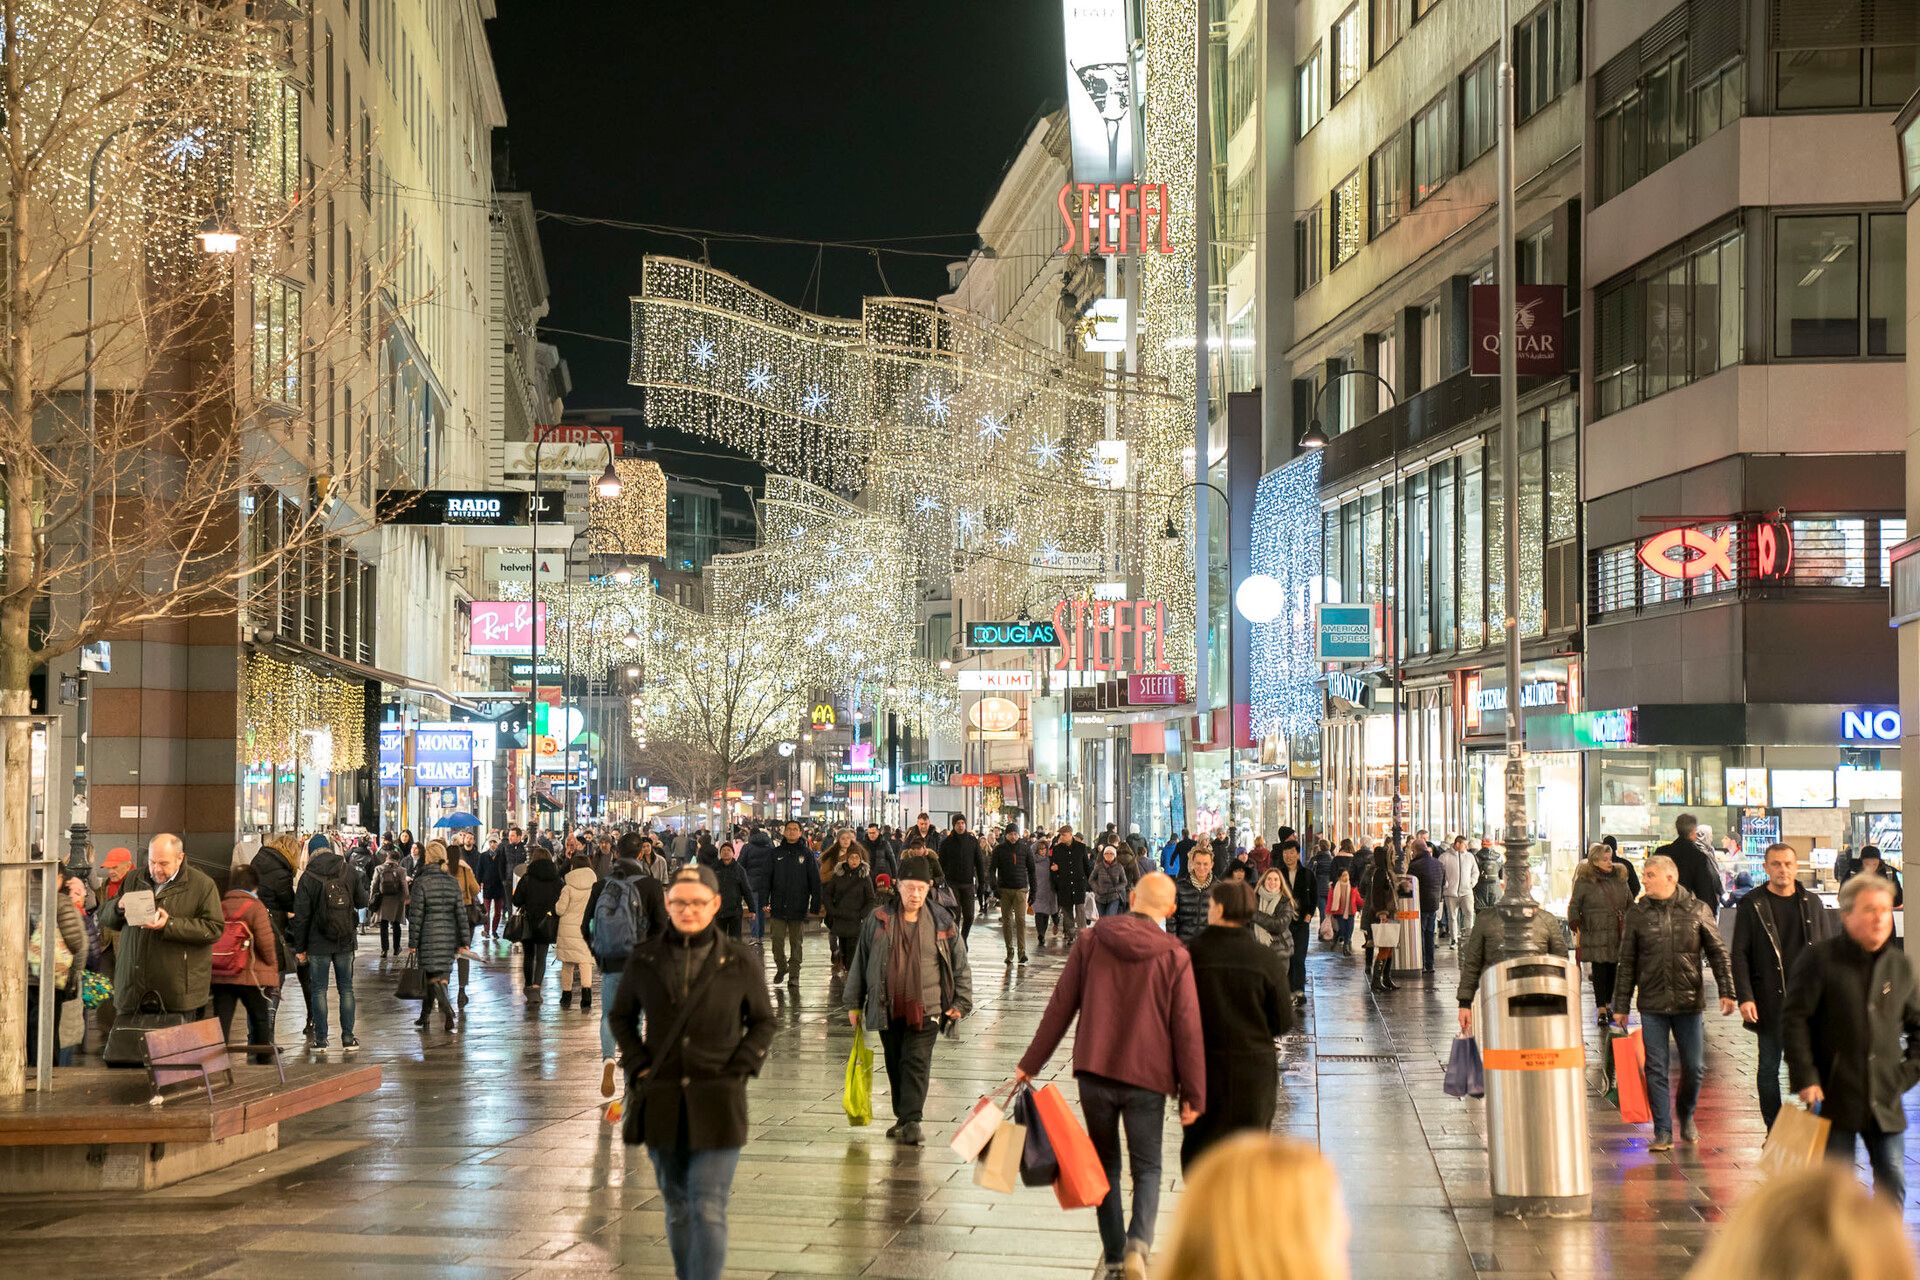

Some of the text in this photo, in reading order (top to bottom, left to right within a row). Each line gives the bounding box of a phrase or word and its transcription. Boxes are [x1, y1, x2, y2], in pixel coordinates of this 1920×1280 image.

[1058, 183, 1174, 254] STEFFL
[1482, 334, 1554, 355] QTAR
[448, 498, 501, 512] RADO
[500, 563, 534, 572] helveti
[974, 625, 1054, 644] DOUGLAS
[1054, 600, 1171, 670] STEFFL
[1321, 624, 1369, 634] AMERICAN
[1330, 634, 1371, 643] EXPRESS
[987, 674, 1031, 686] KLIMT
[1140, 677, 1174, 695] STEFFL
[417, 734, 472, 751] MONEY
[416, 761, 471, 780] CHANGE
